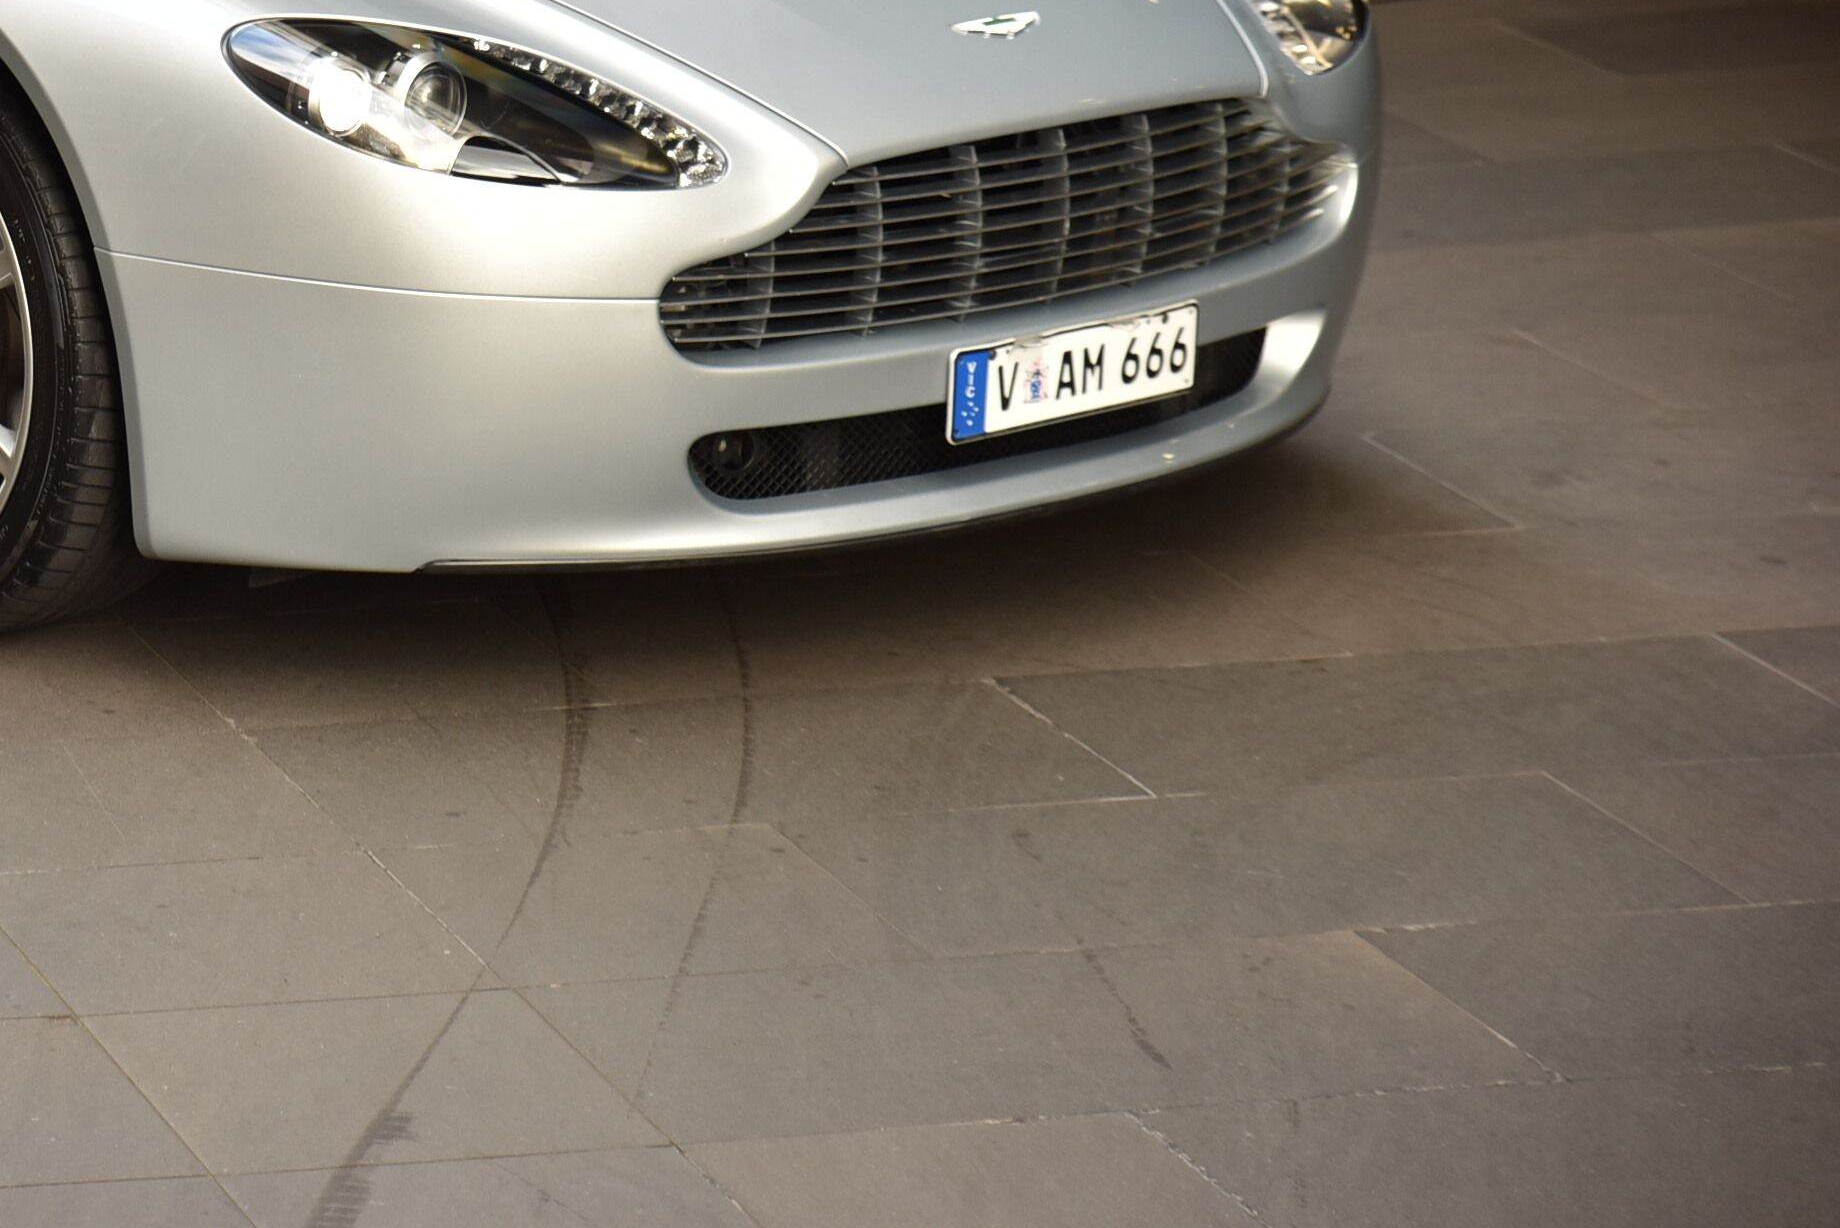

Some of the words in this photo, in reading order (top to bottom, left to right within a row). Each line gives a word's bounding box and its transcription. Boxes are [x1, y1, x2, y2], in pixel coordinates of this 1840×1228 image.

[965, 361, 977, 399] VIC
[998, 361, 1019, 412] V
[1055, 343, 1106, 401] AM
[1121, 326, 1188, 385] 666
